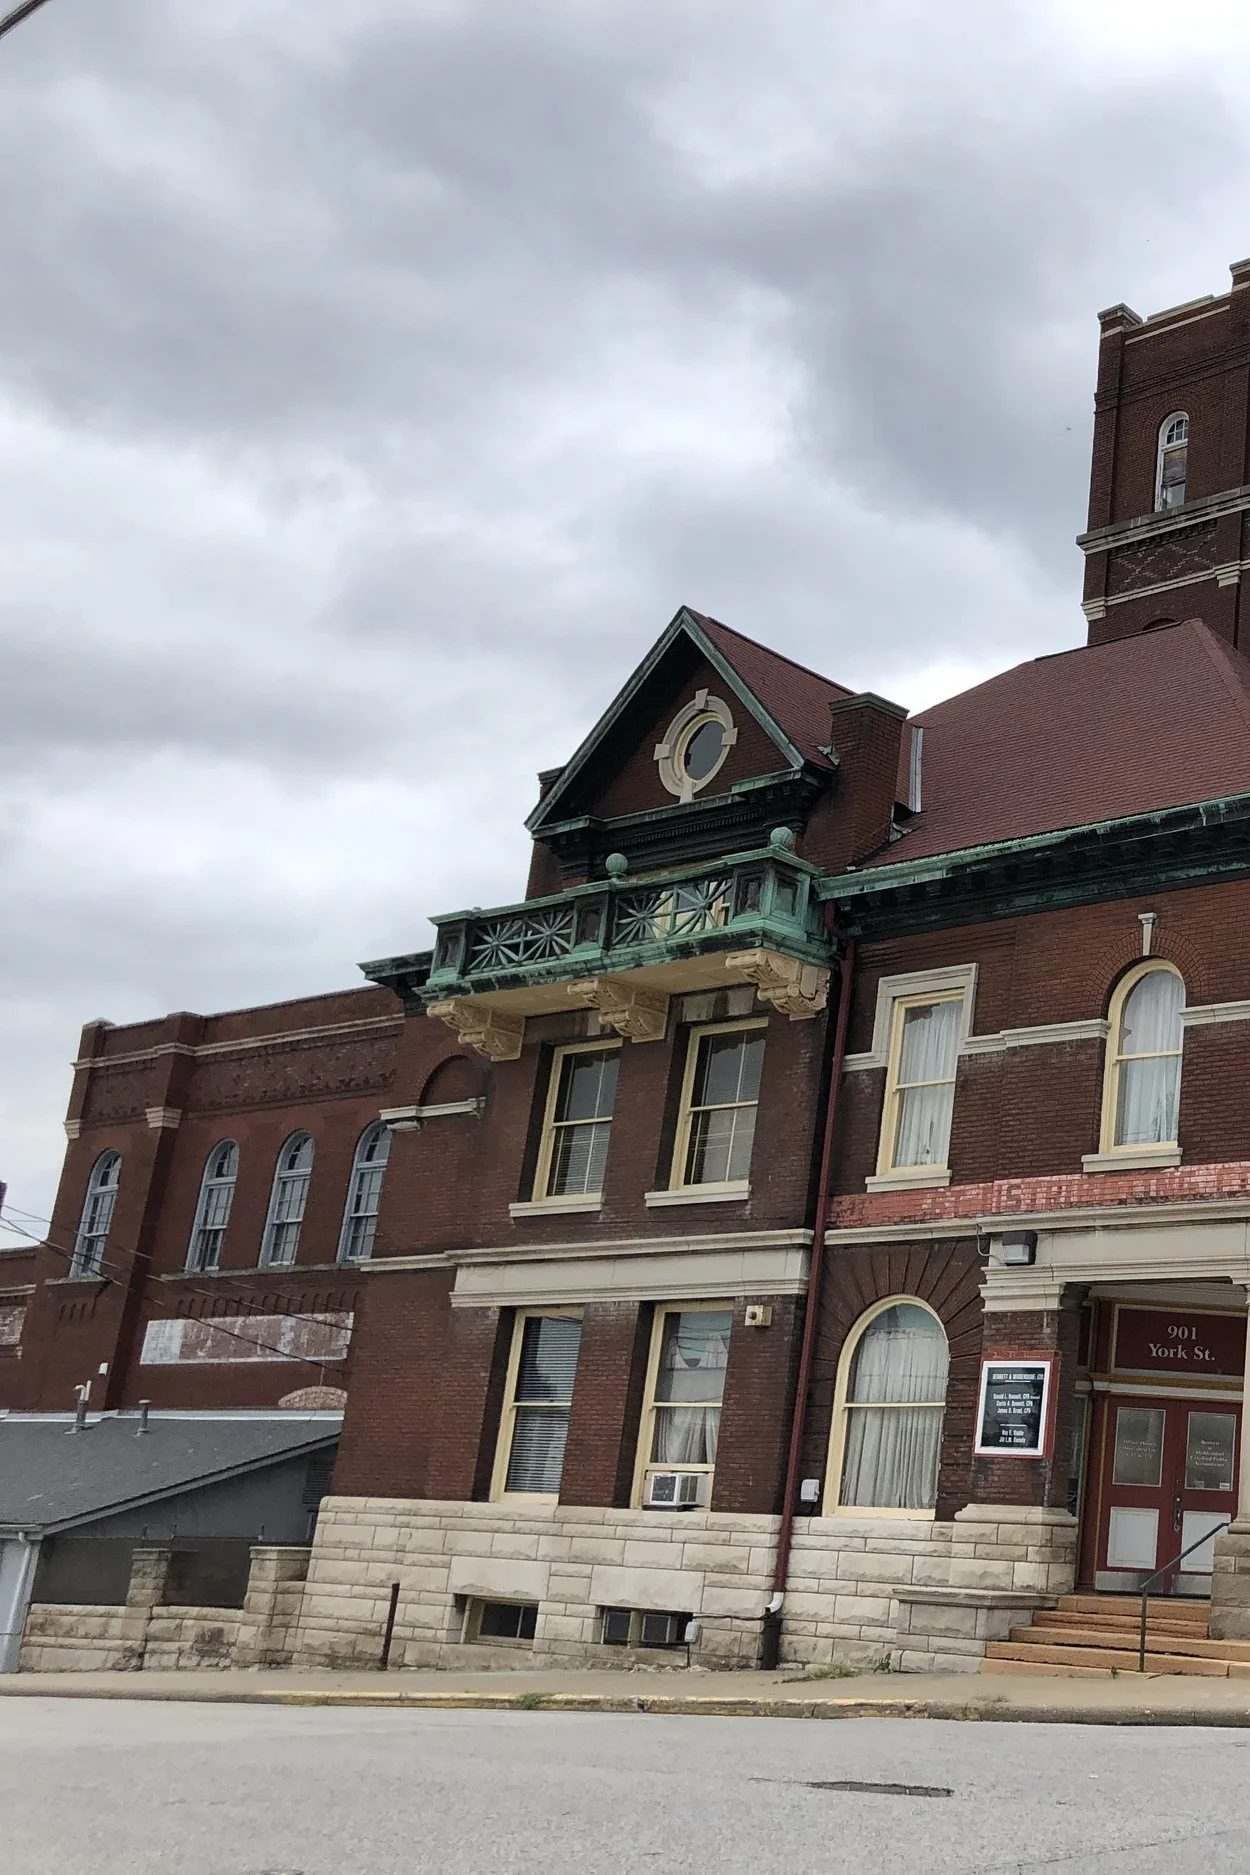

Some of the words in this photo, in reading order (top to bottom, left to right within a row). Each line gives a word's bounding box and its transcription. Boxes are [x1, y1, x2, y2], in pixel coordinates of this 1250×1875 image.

[1167, 1325, 1197, 1340] 901
[1149, 1343, 1188, 1359] York
[1193, 1345, 1216, 1361] St.
